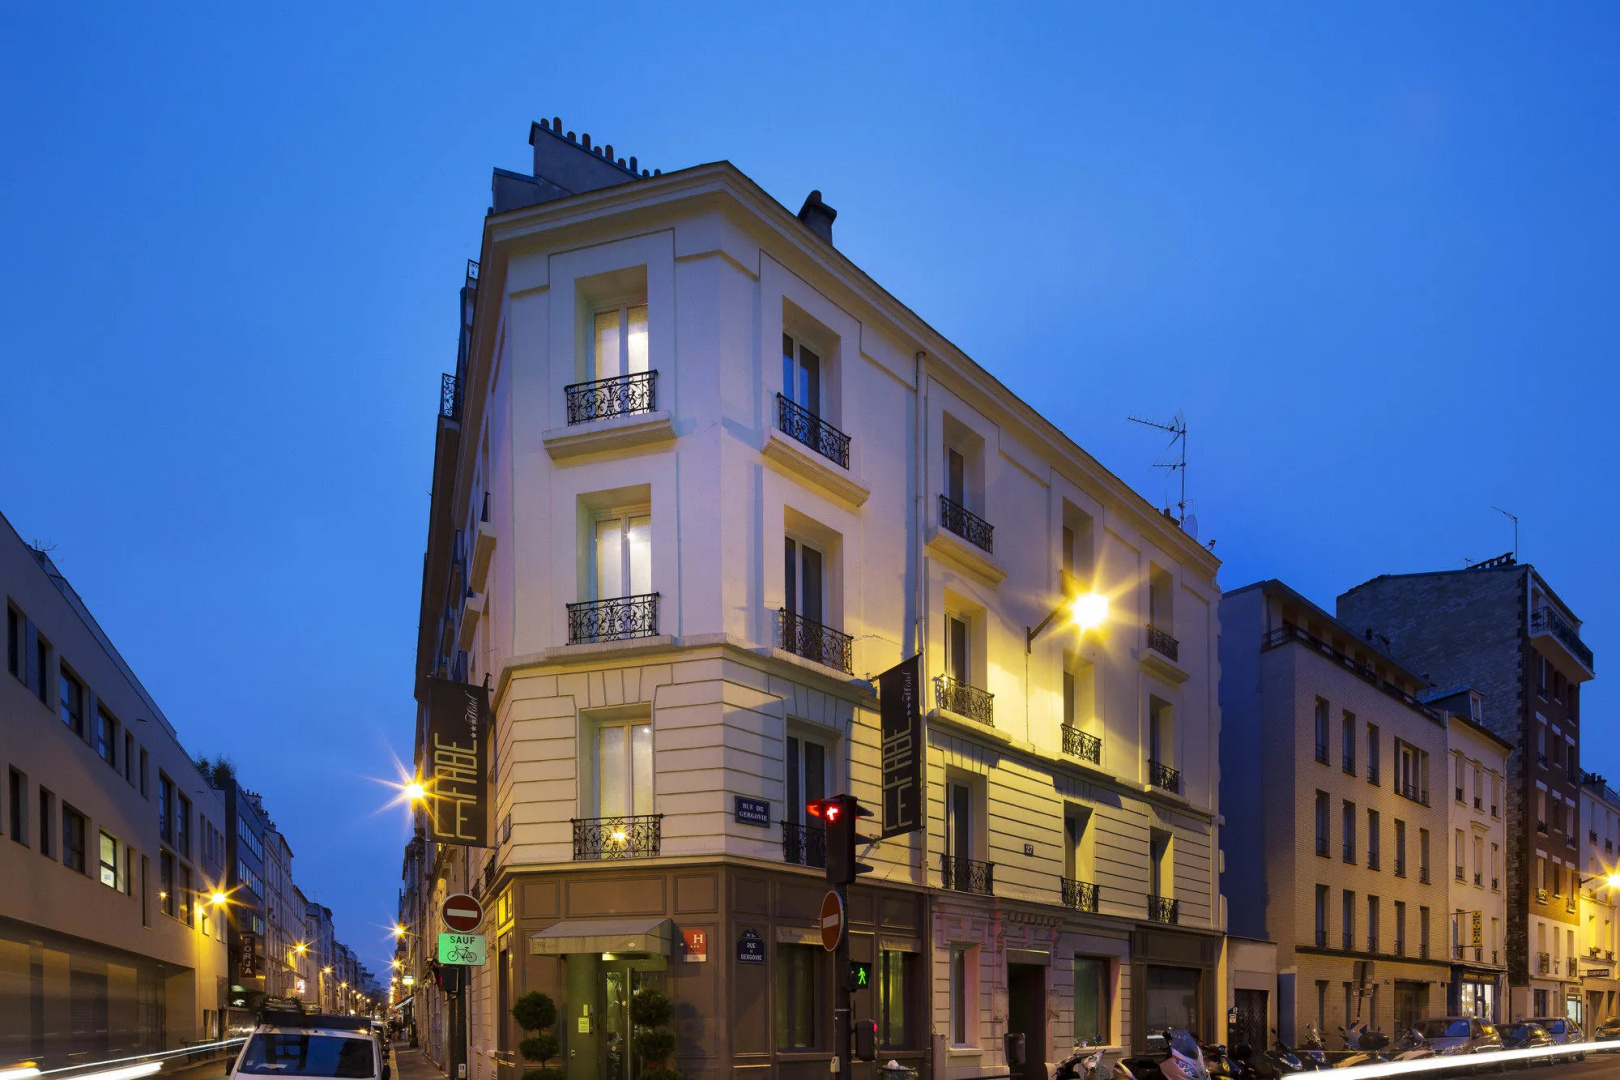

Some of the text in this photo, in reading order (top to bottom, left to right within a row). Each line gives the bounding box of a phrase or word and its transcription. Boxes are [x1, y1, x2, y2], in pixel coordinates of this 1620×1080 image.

[882, 717, 913, 790] FABE
[434, 732, 477, 800] FABE
[739, 811, 768, 822] GERGOVIE
[450, 936, 475, 944] SAUF
[693, 934, 703, 943] H
[244, 938, 253, 975] FORJA
